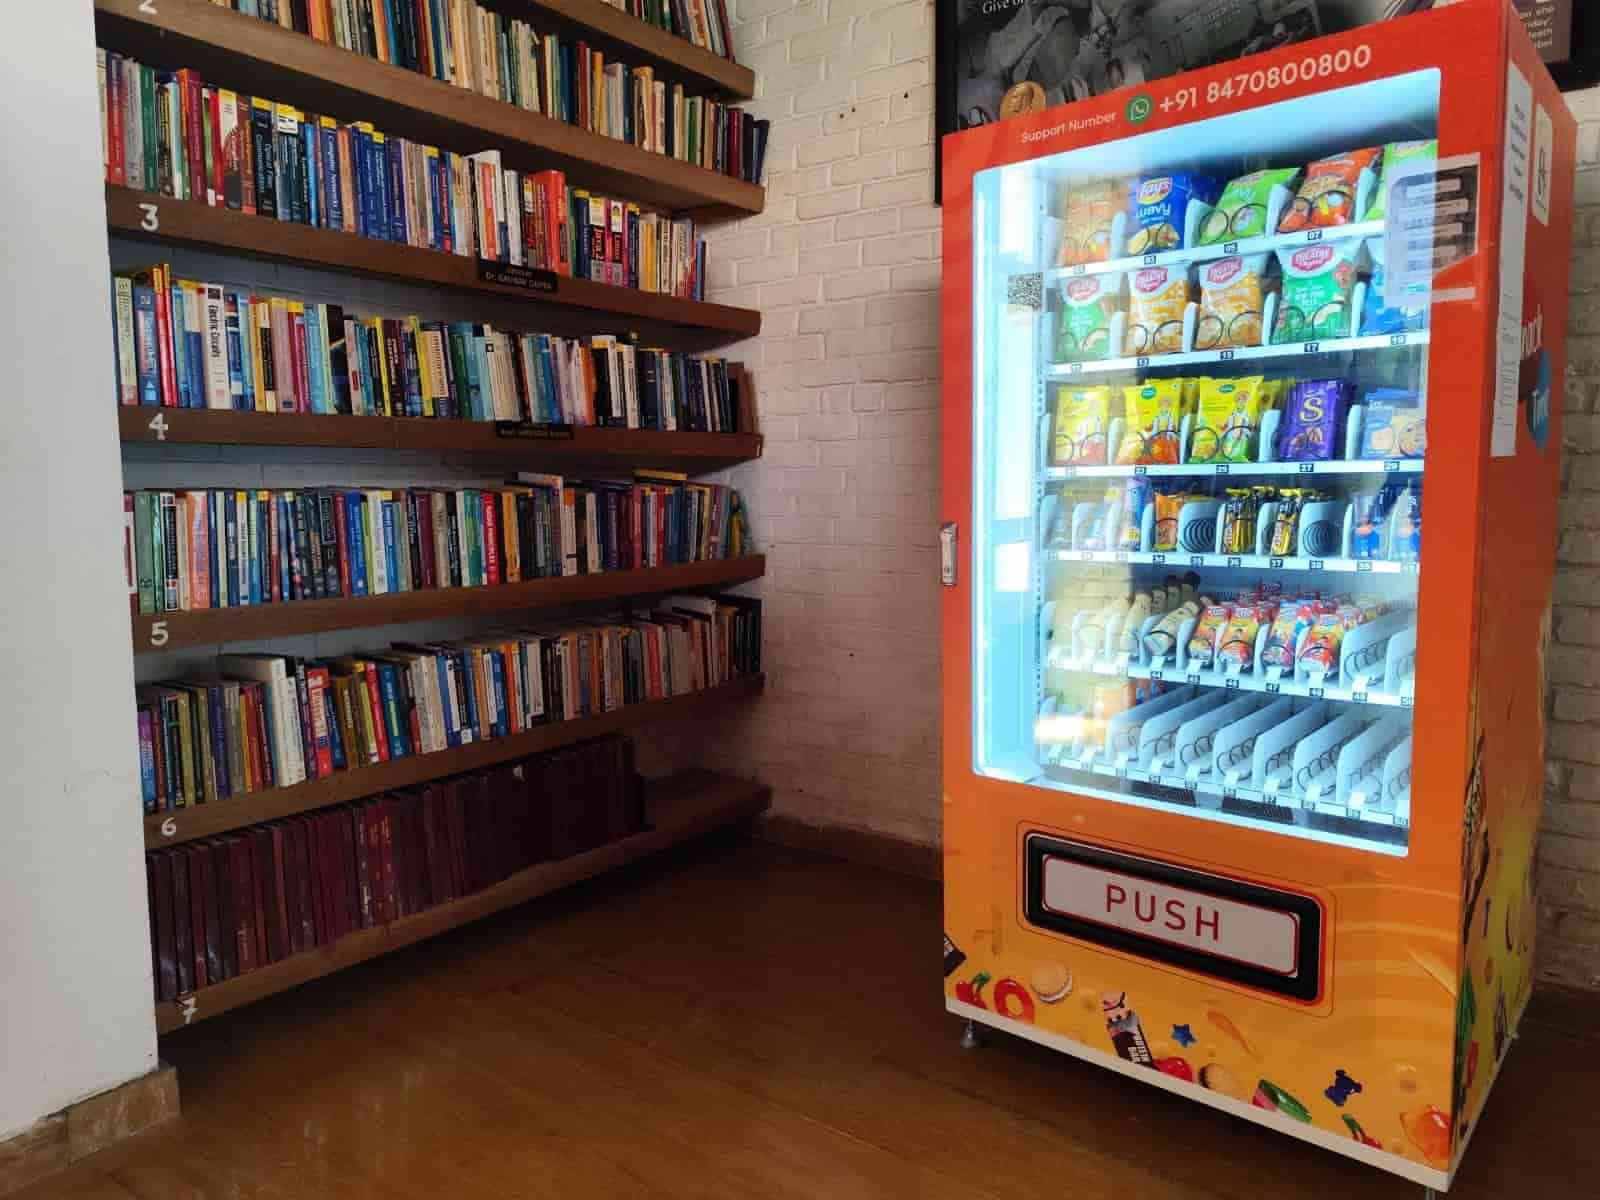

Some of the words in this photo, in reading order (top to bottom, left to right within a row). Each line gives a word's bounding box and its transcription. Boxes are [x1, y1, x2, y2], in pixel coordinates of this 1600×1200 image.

[1021, 122, 1066, 144] Support
[1068, 112, 1117, 133] Number
[1159, 86, 1198, 114] +91
[1206, 44, 1372, 104] 8470800800
[138, 203, 159, 231] 3
[207, 303, 219, 331] Electric
[1300, 396, 1324, 422] S
[148, 412, 169, 441] 4
[150, 620, 169, 646] 5
[160, 816, 177, 837] 6
[1105, 883, 1222, 942] PUSH
[177, 996, 199, 1025] 7
